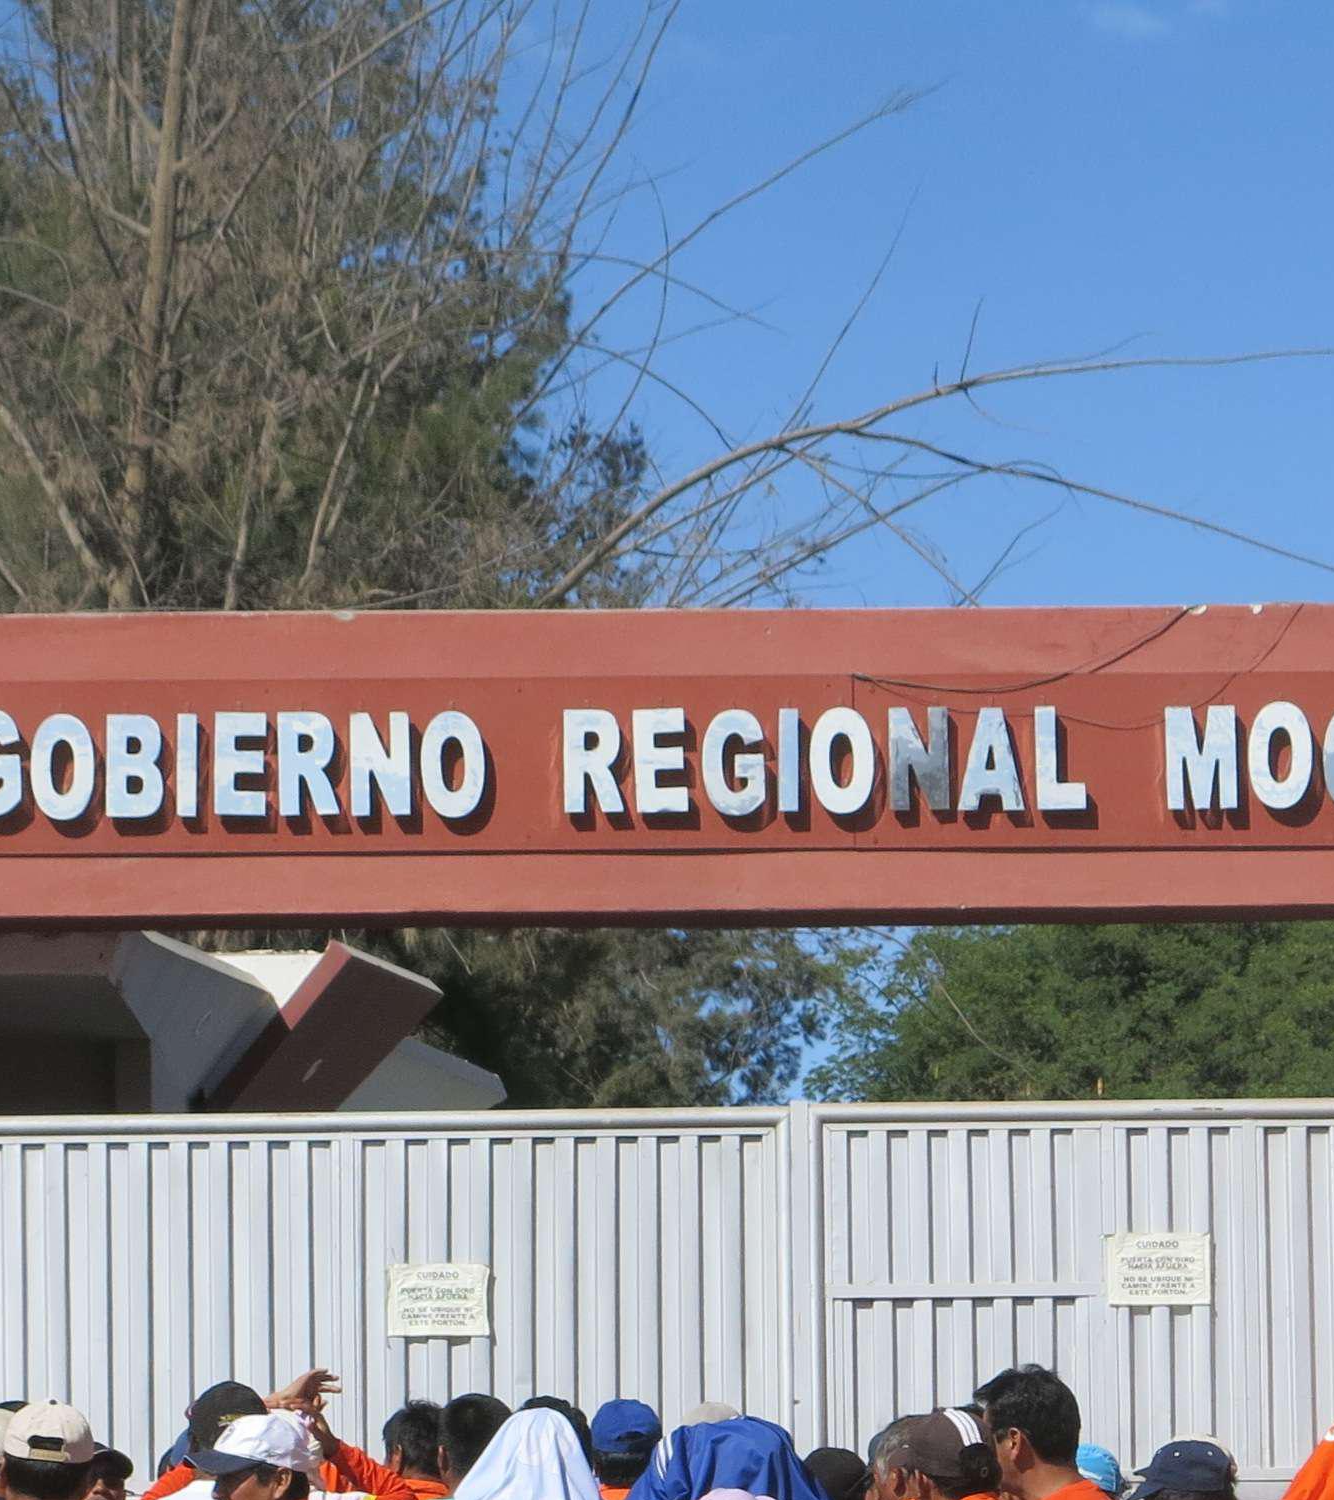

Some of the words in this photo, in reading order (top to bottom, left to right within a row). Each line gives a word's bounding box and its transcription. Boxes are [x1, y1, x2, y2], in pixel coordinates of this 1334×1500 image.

[562, 705, 1087, 816] REGIONAL
[1136, 1241, 1179, 1249] CUIDADO
[417, 1271, 460, 1280] CUIDADO
